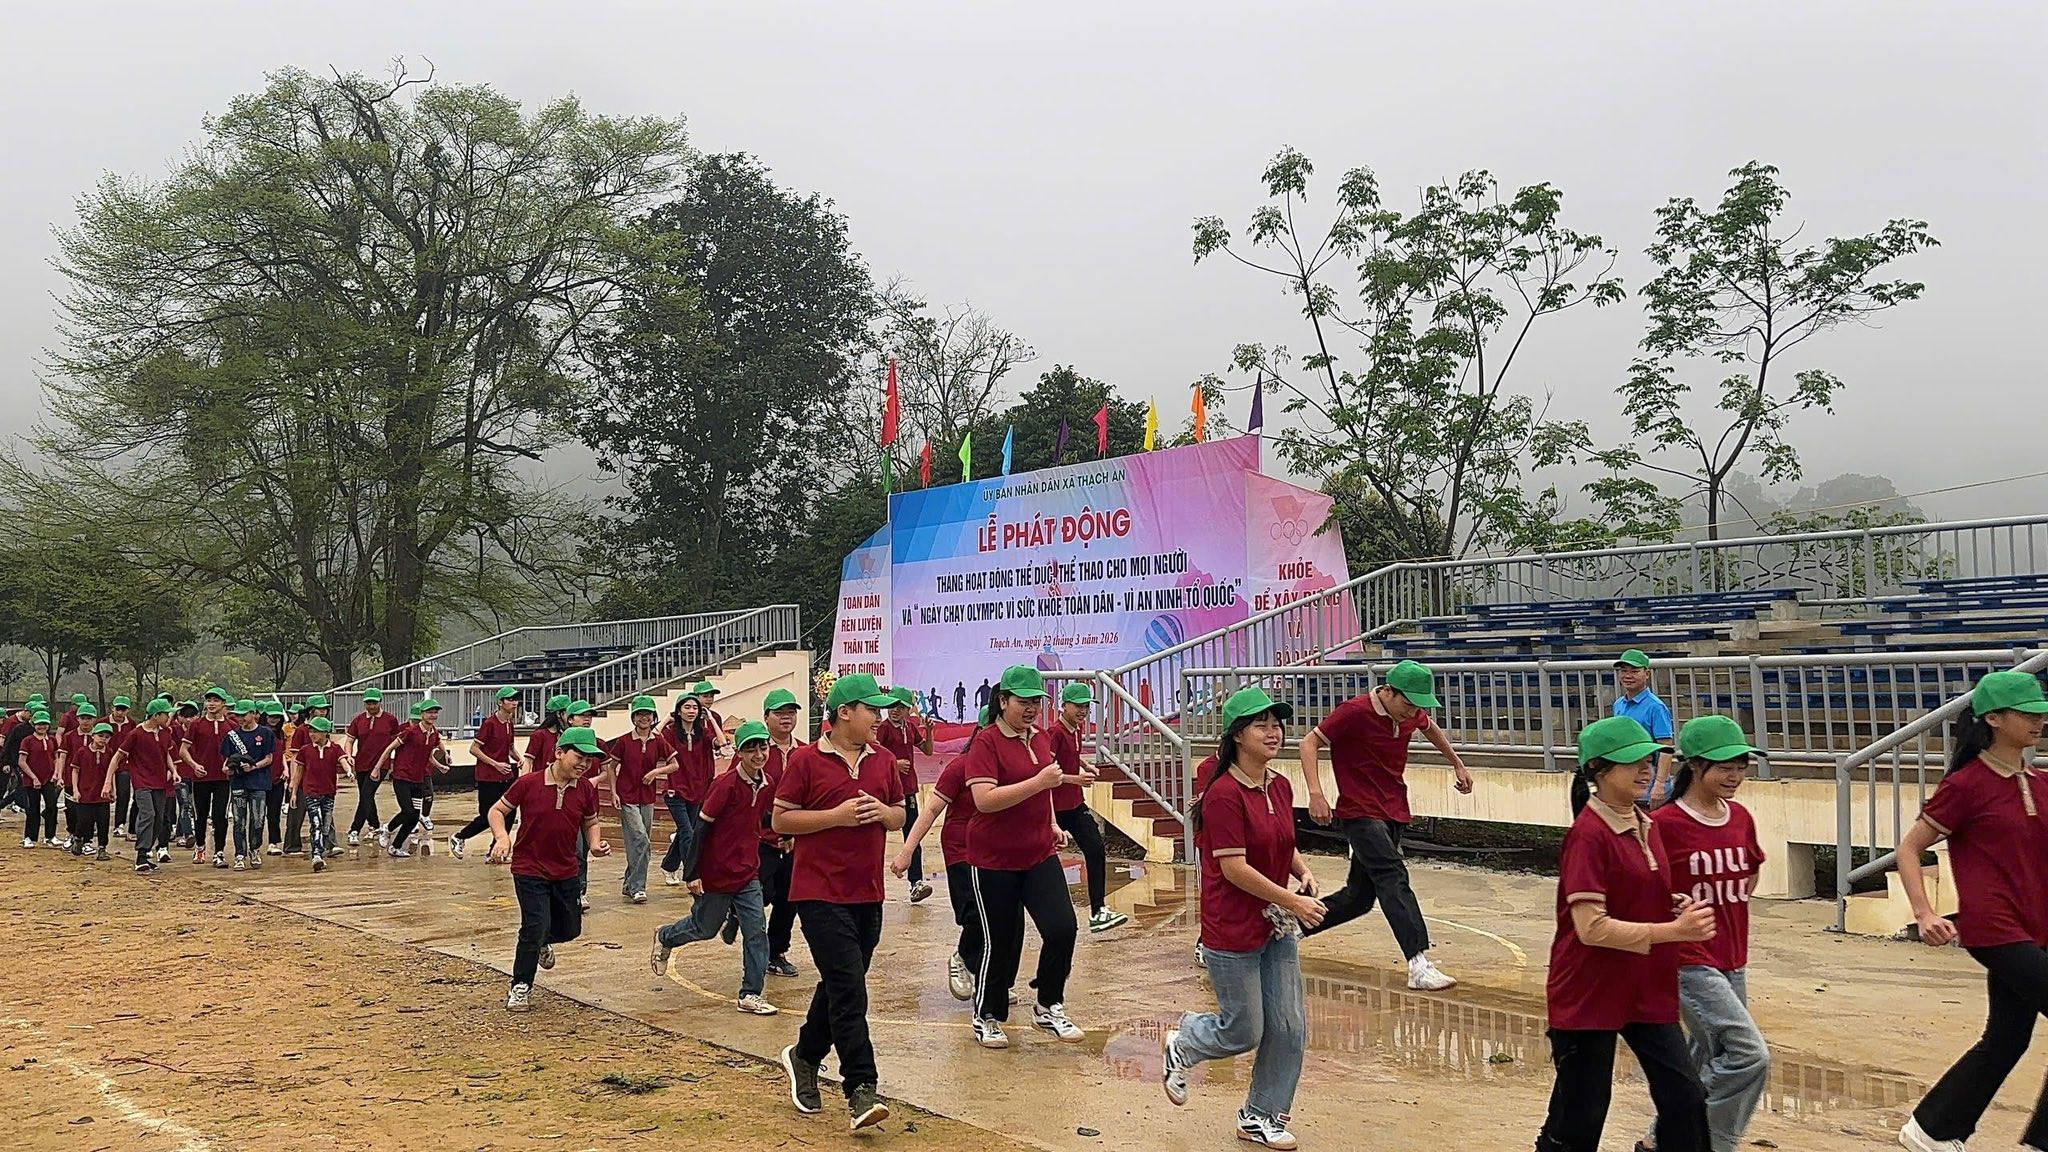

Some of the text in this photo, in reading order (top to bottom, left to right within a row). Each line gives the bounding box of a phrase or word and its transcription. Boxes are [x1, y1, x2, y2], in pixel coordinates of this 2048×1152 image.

[984, 469, 1126, 501] ỦY BAN NHÂN DÂN XÃ THẠCH AN
[978, 506, 1132, 552] LỄ PHÁT ĐỘNG
[936, 572, 964, 594] THÁNG
[966, 572, 988, 594] HOẠT
[989, 566, 1014, 592] ĐỘNG
[1016, 560, 1032, 586] THỂ
[1058, 554, 1076, 582] THỂ
[1078, 560, 1104, 582] THAO
[1106, 558, 1127, 578] CHO
[1130, 556, 1150, 580] MỌI
[1154, 548, 1188, 575] NGƯỜI
[1278, 556, 1313, 581] KHỎE
[864, 592, 880, 608] DÂN
[902, 605, 912, 626] VÀ
[920, 603, 942, 624] NGÀY
[944, 604, 966, 626] CHẠY
[967, 602, 1004, 622] OLYMPIC
[1006, 596, 1014, 620] VÌ
[1016, 596, 1035, 618] SỨC
[1065, 592, 1090, 616] TOÀN
[1094, 590, 1114, 614] DÂN
[1124, 588, 1134, 612] VÌ
[1137, 590, 1151, 611] AN
[1155, 588, 1183, 610] NINH
[1186, 578, 1200, 608] TỔ
[1254, 587, 1271, 611] ĐỂ
[1274, 589, 1299, 610] XÂY
[858, 614, 882, 634] LUYỆN
[844, 634, 880, 654] THÂN THỂ
[990, 637, 1010, 650] Thạch
[1010, 638, 1024, 650] An,
[1024, 638, 1042, 650] ngày
[1053, 635, 1074, 648] tháng
[1075, 634, 1080, 646] 3
[1082, 634, 1098, 645] năm
[1100, 632, 1119, 644] 2026
